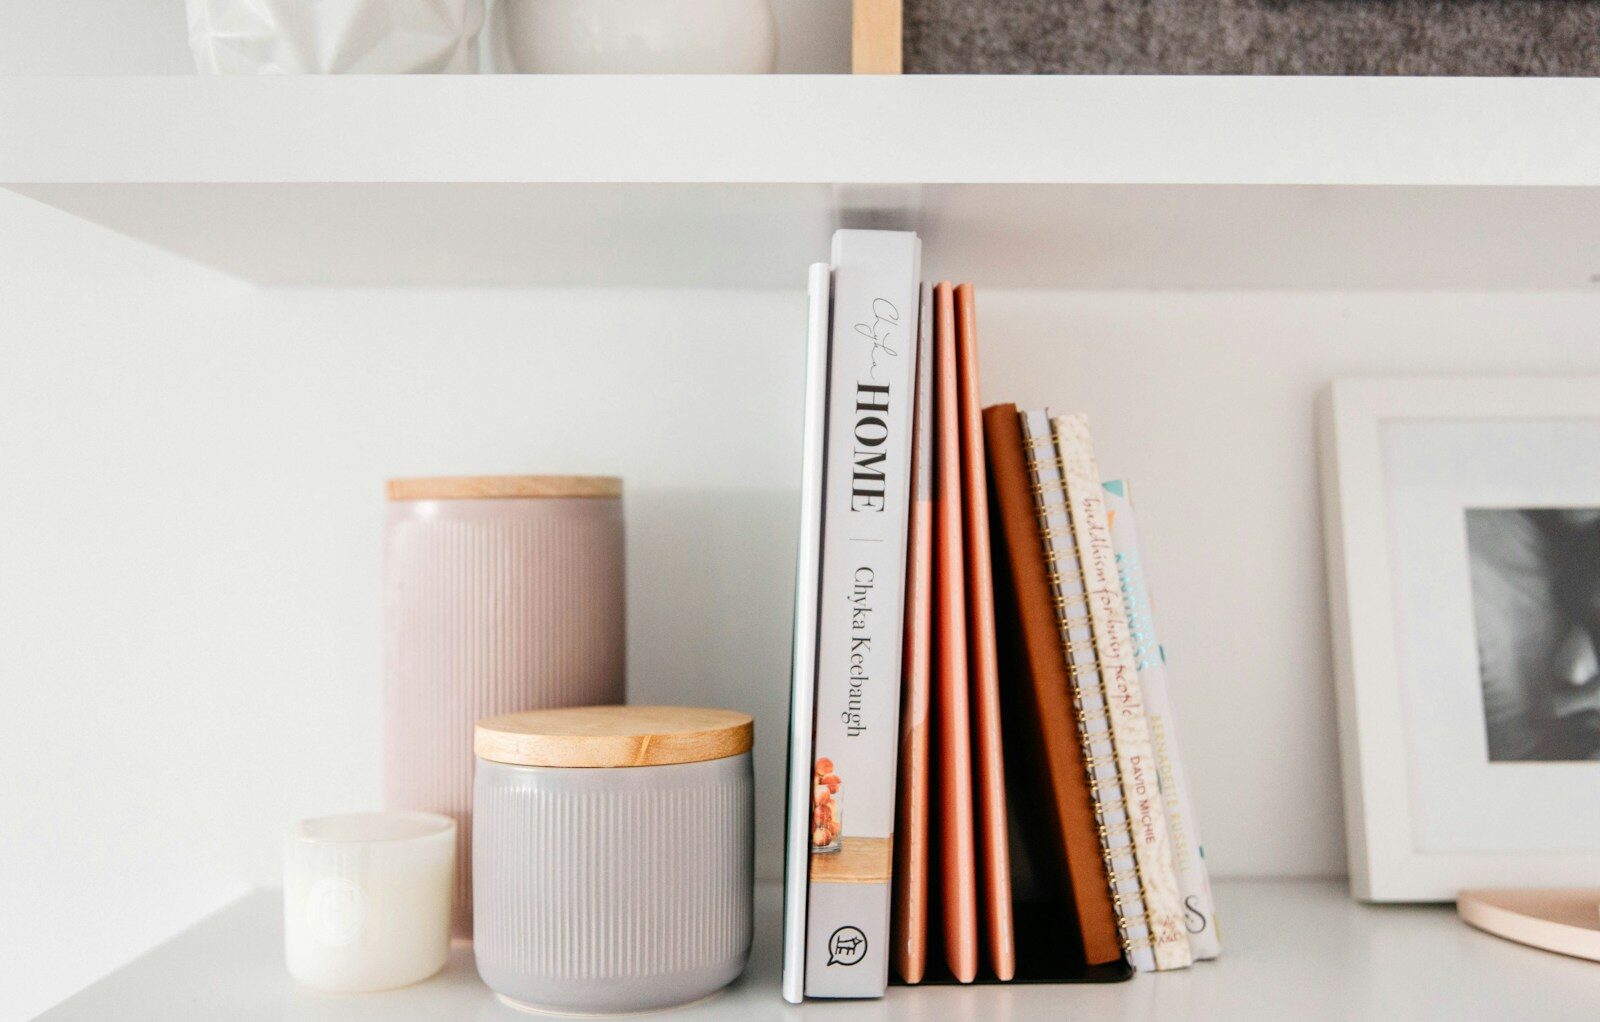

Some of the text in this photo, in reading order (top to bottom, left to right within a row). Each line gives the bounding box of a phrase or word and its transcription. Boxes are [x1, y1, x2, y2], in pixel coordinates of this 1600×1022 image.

[851, 380, 890, 512] HOME
[841, 566, 875, 737] Chyka Keebaugh
[1083, 498, 1140, 717] buddhism for busy people
[1130, 756, 1156, 845] DAVID MICHIE
